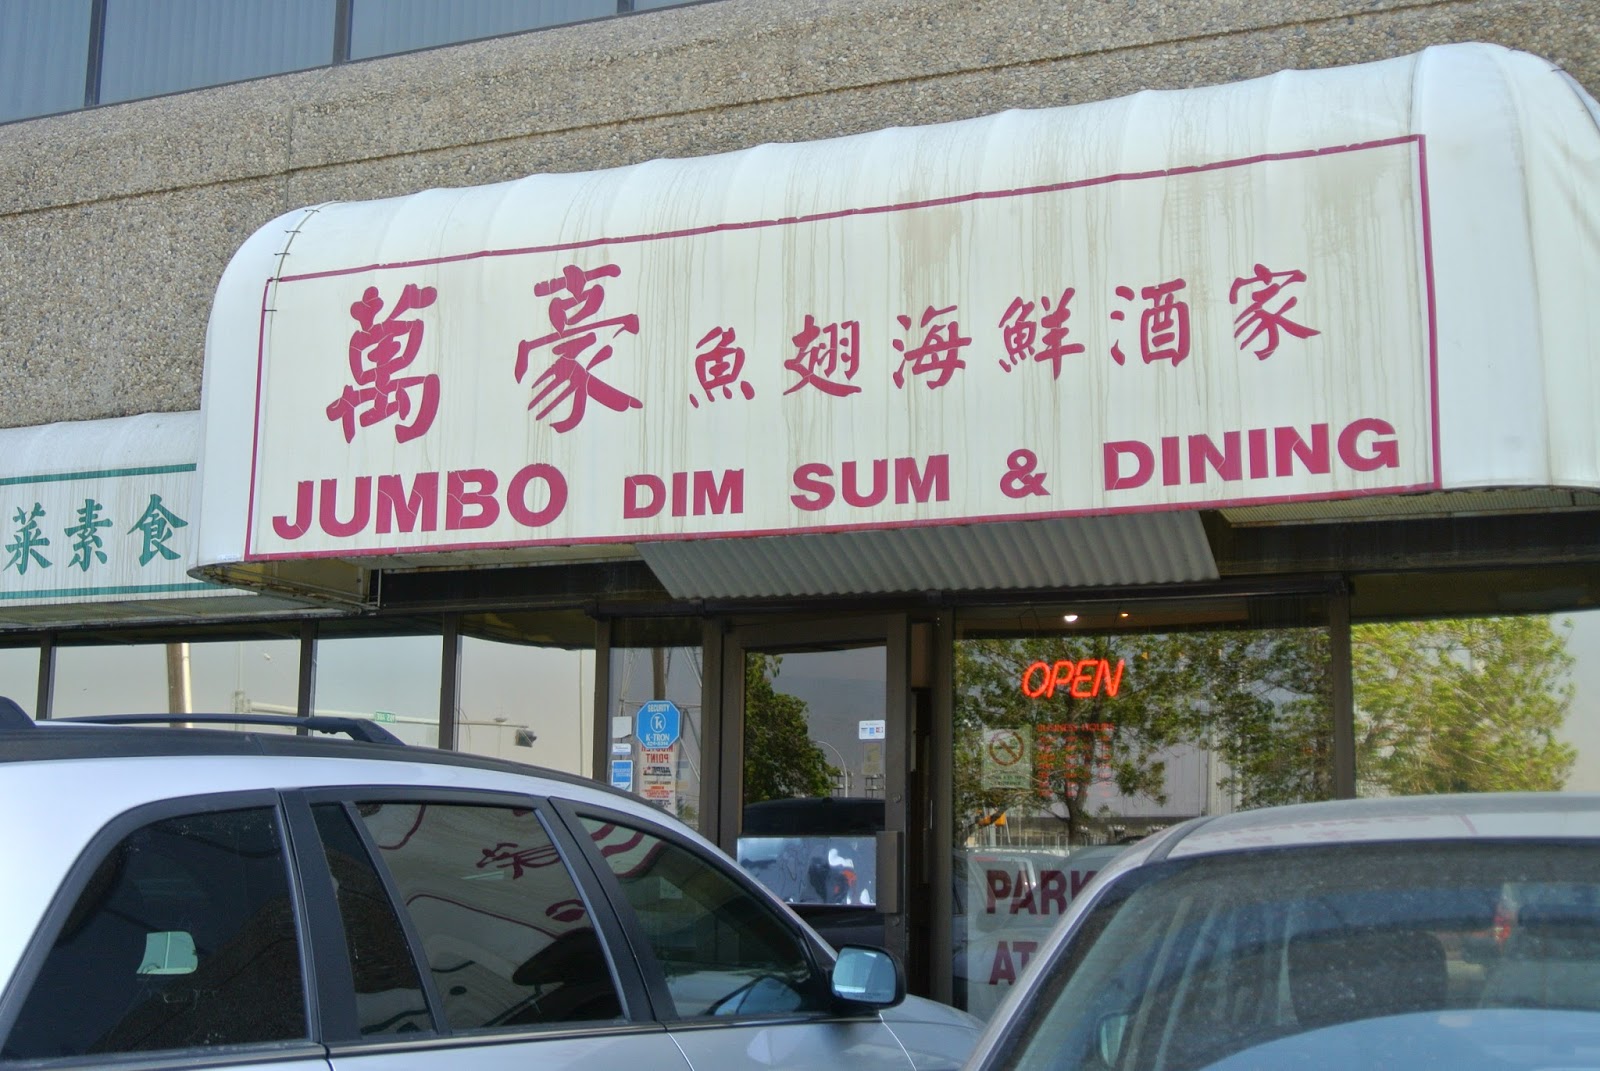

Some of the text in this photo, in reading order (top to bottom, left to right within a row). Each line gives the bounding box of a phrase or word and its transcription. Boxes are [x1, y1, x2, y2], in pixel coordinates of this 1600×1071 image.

[273, 418, 1401, 539] JUMBO DIM SUM & DINING
[1021, 658, 1126, 699] OPEN
[647, 703, 670, 713] SECURITY
[645, 733, 671, 742] K-TRON
